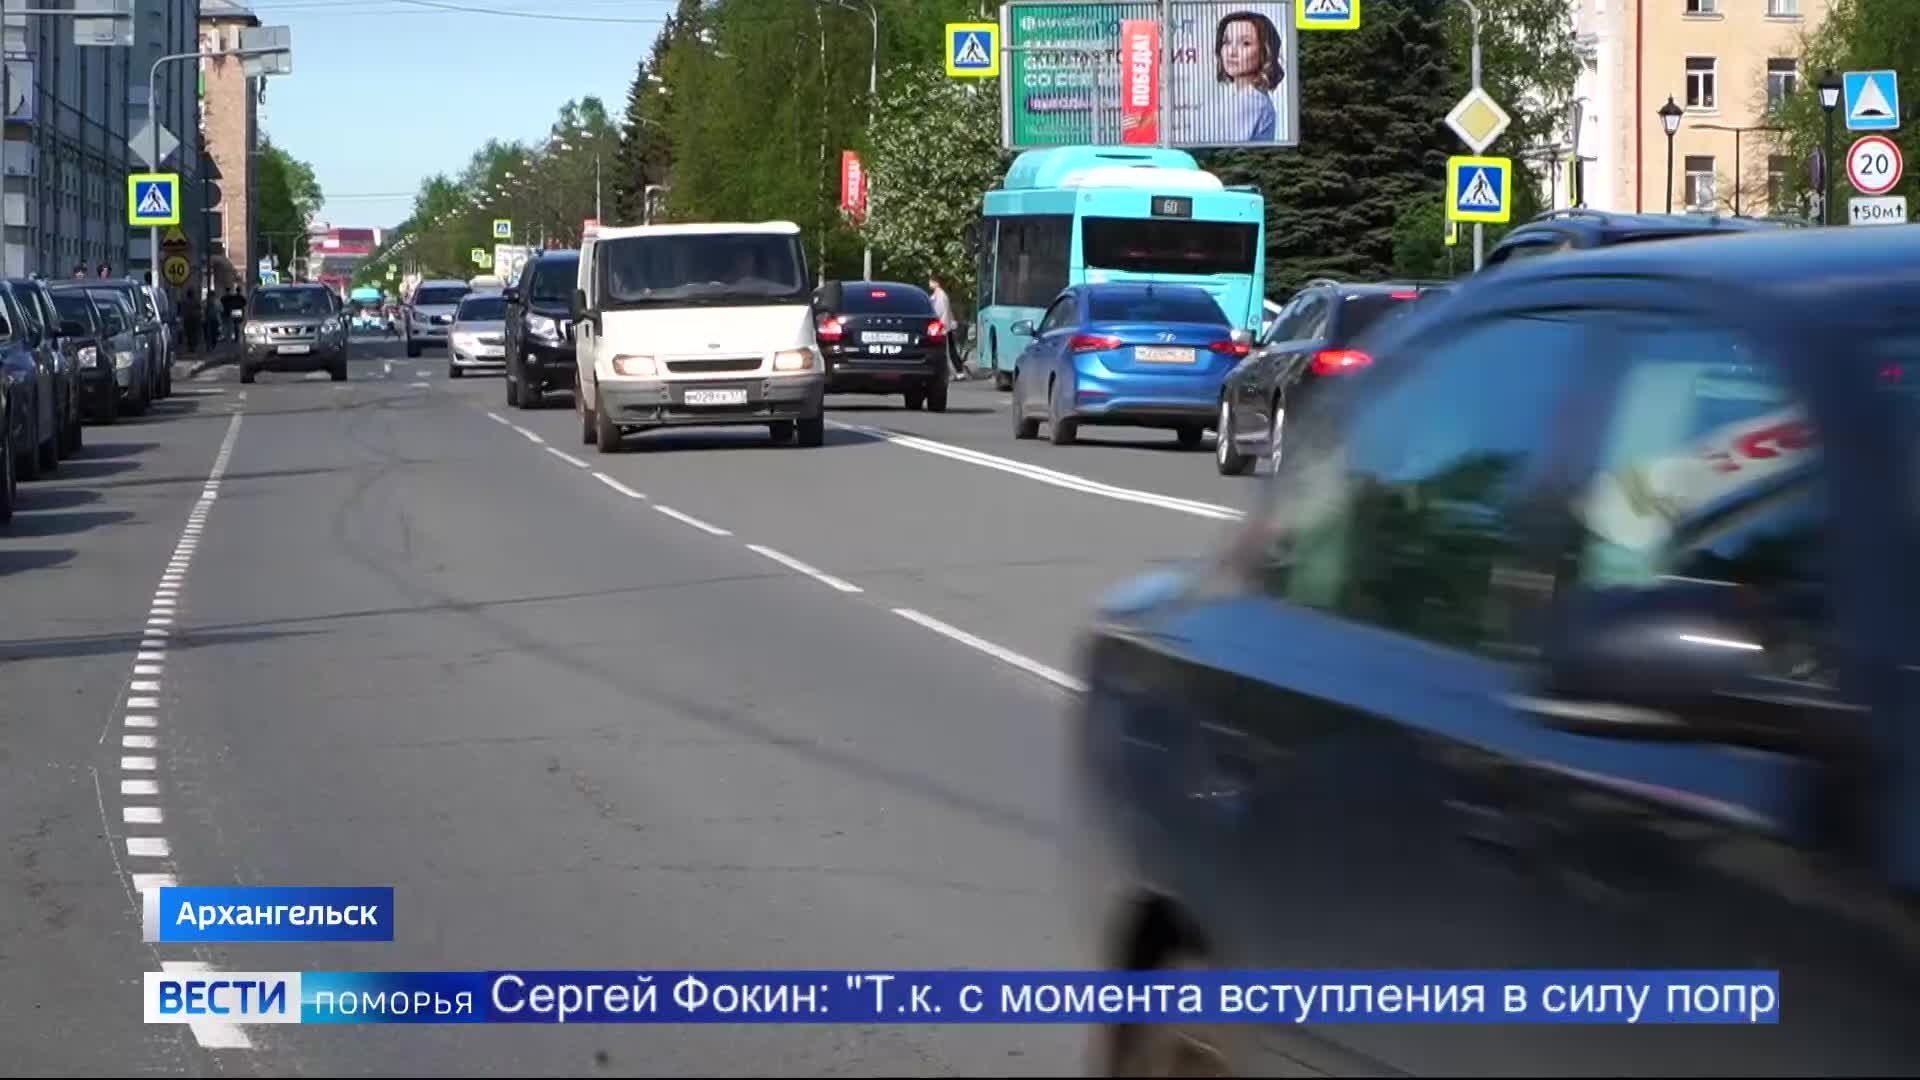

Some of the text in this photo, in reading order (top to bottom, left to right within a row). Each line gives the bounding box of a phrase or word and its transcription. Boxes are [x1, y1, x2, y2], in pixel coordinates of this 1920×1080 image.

[1131, 33, 1152, 107] ПОБЕДА!
[1860, 153, 1889, 175] 20
[168, 263, 185, 277] 40
